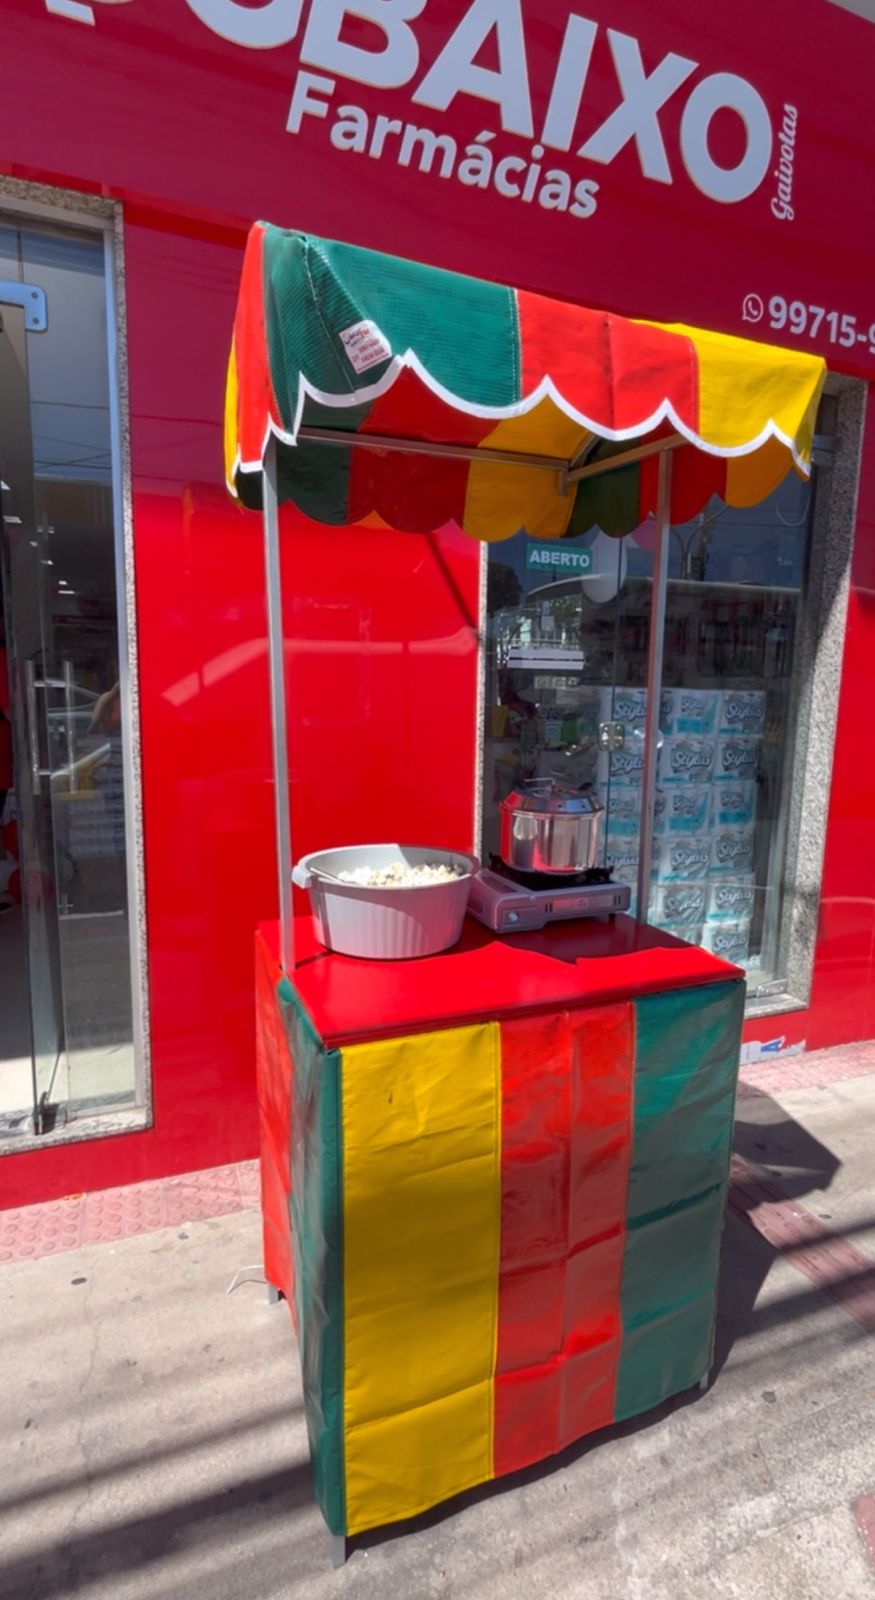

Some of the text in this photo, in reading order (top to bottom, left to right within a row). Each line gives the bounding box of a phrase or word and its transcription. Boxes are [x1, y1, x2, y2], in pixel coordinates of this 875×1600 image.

[286, 70, 599, 218] Farmácias
[771, 103, 798, 221] Gaivotas
[529, 550, 590, 568] ABERTO
[671, 751, 711, 770] Stylus
[671, 850, 709, 867] Stylus
